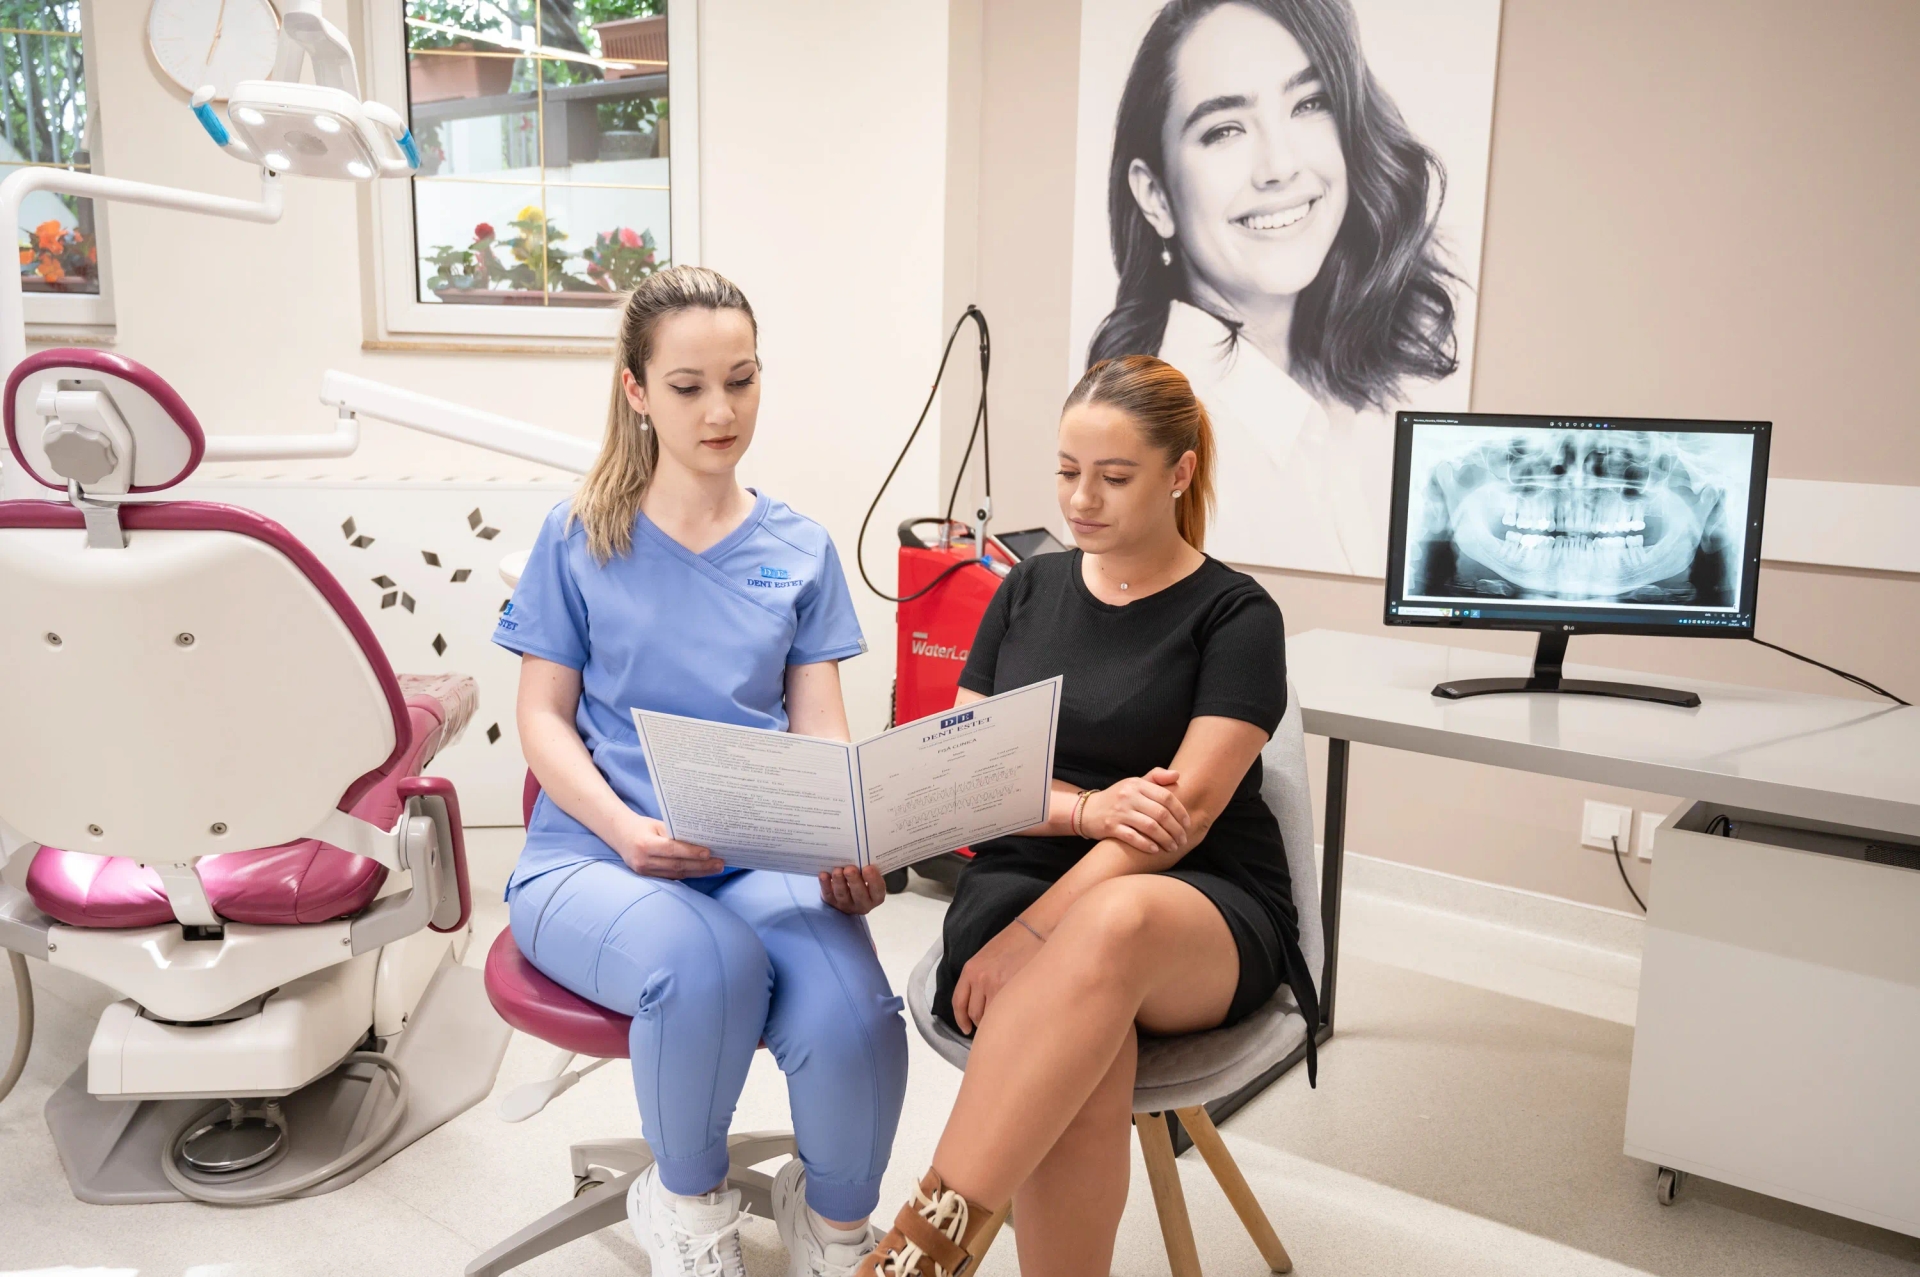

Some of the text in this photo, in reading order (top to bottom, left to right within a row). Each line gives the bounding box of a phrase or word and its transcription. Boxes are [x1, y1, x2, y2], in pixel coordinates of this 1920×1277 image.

[747, 579, 803, 588] DENT ESTET
[922, 728, 954, 743] DENT
[957, 716, 992, 731] ESTET
